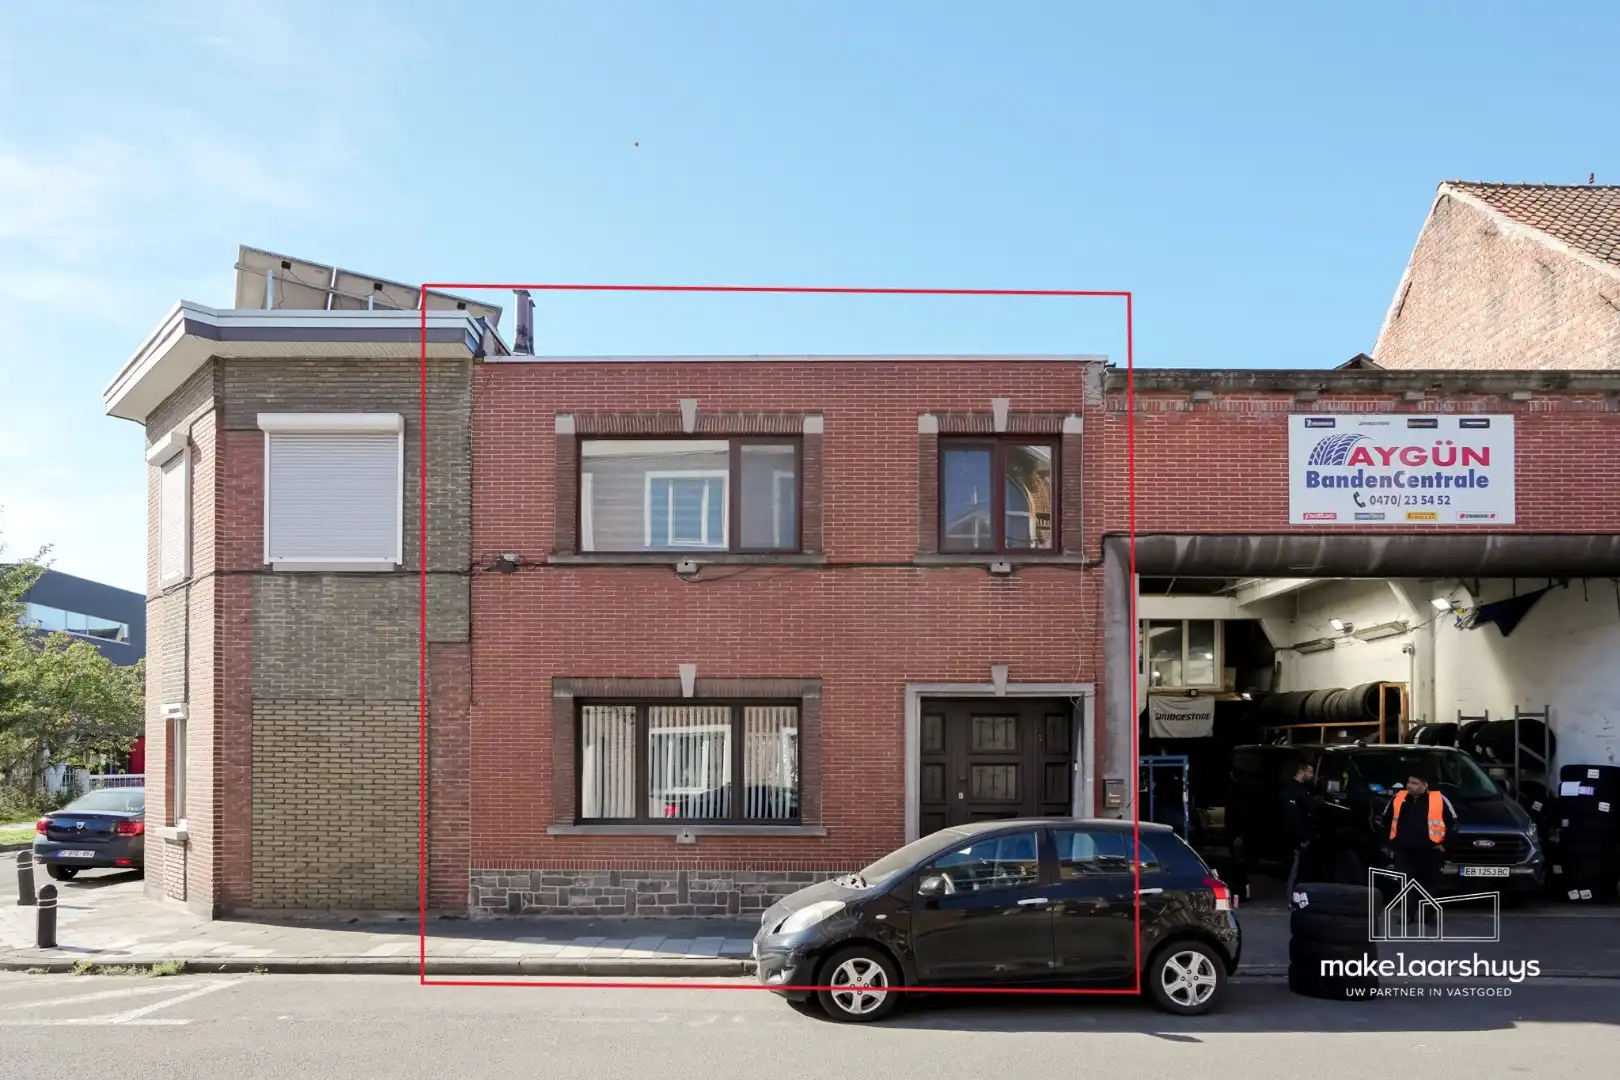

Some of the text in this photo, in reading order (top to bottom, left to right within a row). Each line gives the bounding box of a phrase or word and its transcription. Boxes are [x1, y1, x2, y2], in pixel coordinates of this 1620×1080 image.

[1347, 440, 1490, 467] AYGÜN
[1306, 469, 1489, 489] BandenCentrale
[1369, 494, 1451, 507] 0470/ 23 54 52
[1465, 868, 1509, 876] EB 1253 BC
